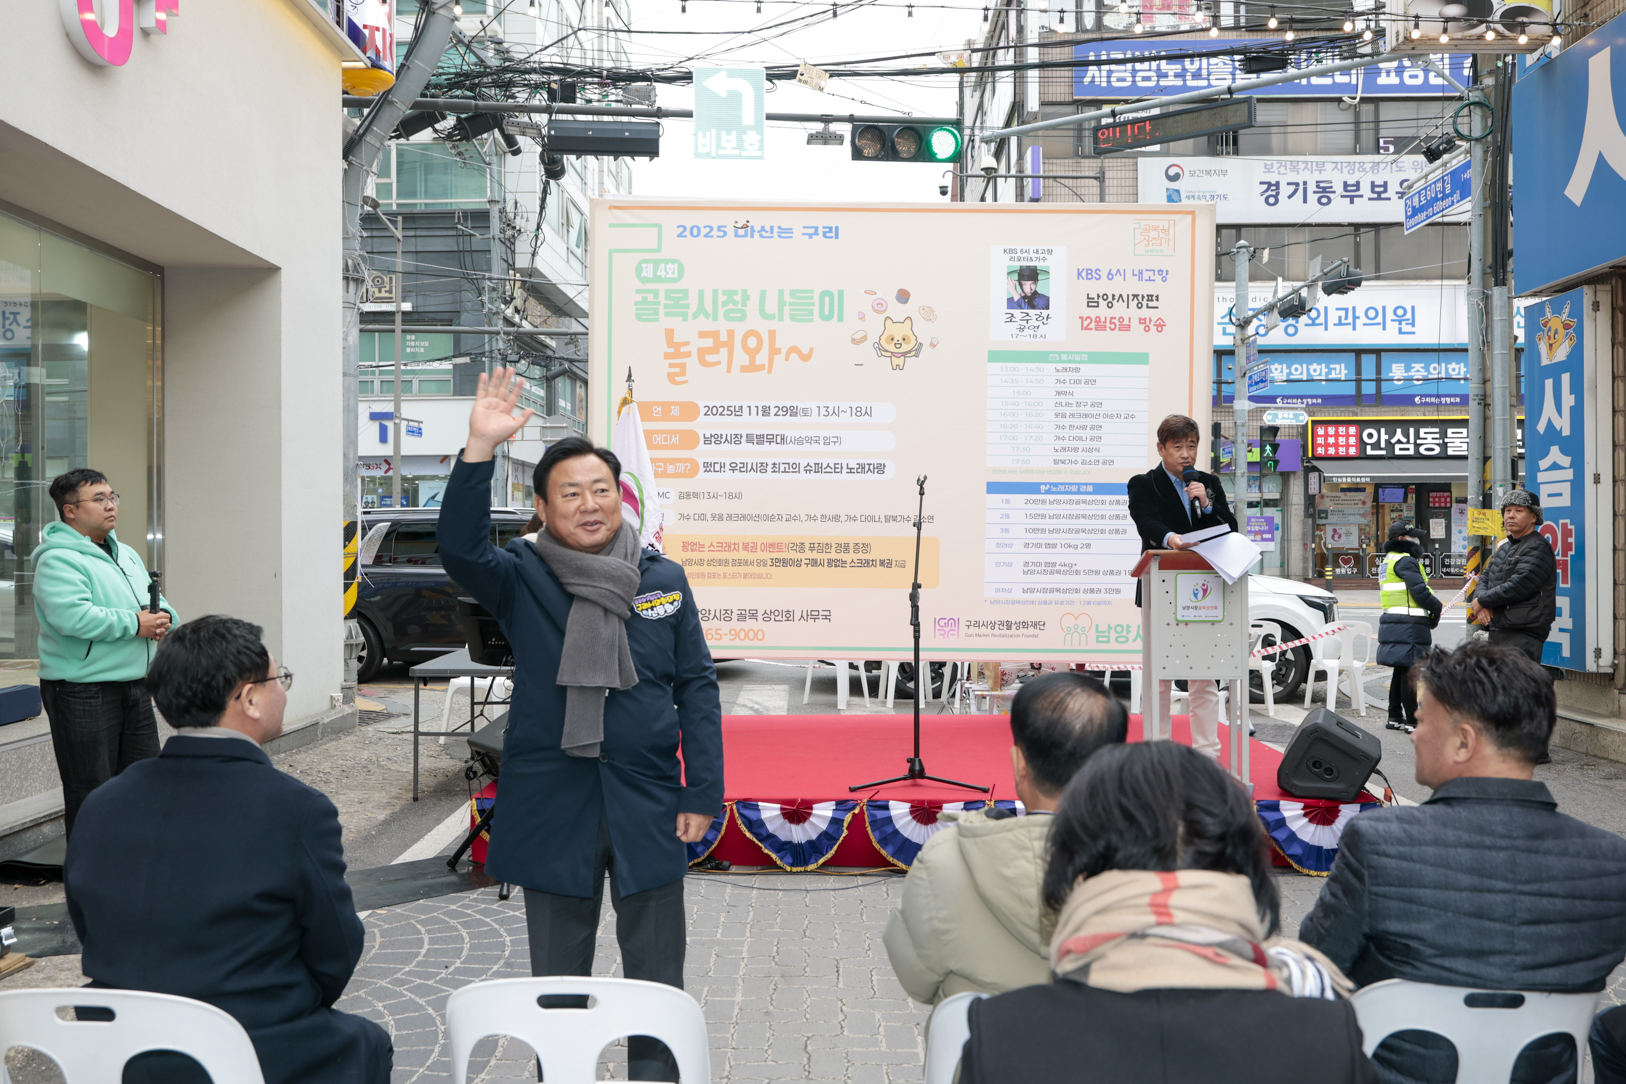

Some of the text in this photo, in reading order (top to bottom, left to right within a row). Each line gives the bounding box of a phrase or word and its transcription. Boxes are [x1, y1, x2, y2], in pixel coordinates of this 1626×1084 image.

[699, 130, 762, 156] 비보호
[1379, 137, 1394, 154] 5
[1188, 169, 1228, 178] 보건복지부
[1263, 160, 1407, 175] 보건복지부 지정&경기도
[1208, 194, 1229, 202] 경기도
[1406, 174, 1451, 216] 검배로60번길
[1406, 190, 1460, 229] Geombae-ro 60beon-gil
[676, 224, 728, 238] 2025
[802, 225, 839, 240] 구리
[1033, 248, 1053, 256] 내고향
[641, 263, 678, 278] 제 4회
[1077, 268, 1169, 283] KBS 6시 내고향
[634, 288, 844, 323] 골목시장 나들이
[1086, 293, 1159, 309] 남양시장편
[1004, 312, 1052, 325] 조주한
[1079, 316, 1167, 333] 12월5일 방송
[1016, 324, 1041, 332] 공연
[663, 327, 814, 386] 놀러와~
[1270, 363, 1348, 384] 활의학과
[1389, 362, 1469, 384] 통증의학
[703, 405, 873, 418] 2025년 11월 29일(토) 13시~18시
[652, 434, 680, 445] 어디서
[703, 433, 842, 446] 남양시장 특별무대(사슴약국 입구)
[666, 463, 691, 474] 놀까?
[703, 462, 886, 475] 떴다! 우리시장 최고의 슈퍼스타 노래자랑
[678, 491, 743, 500] 김동혁(13시~18시)
[678, 513, 912, 524] 가수 다미, 웃음 레크레이션(이순자 교수), 가수 한사랑, 가수 다이나, 탈북가수
[682, 541, 872, 554] 꽝없는 스크래치 복권 이벤트!(각종 푸짐한 경품 증정)
[681, 557, 906, 569] 남양시장 상인회원 점포에서 당일 3만원이상 구매시 꽝없는 스크래치 복권 지급
[698, 608, 832, 623] 양시장 골목 상인회 사무국
[965, 620, 1046, 631] 구리시상권활성화재단
[704, 628, 765, 642] 65-9000
